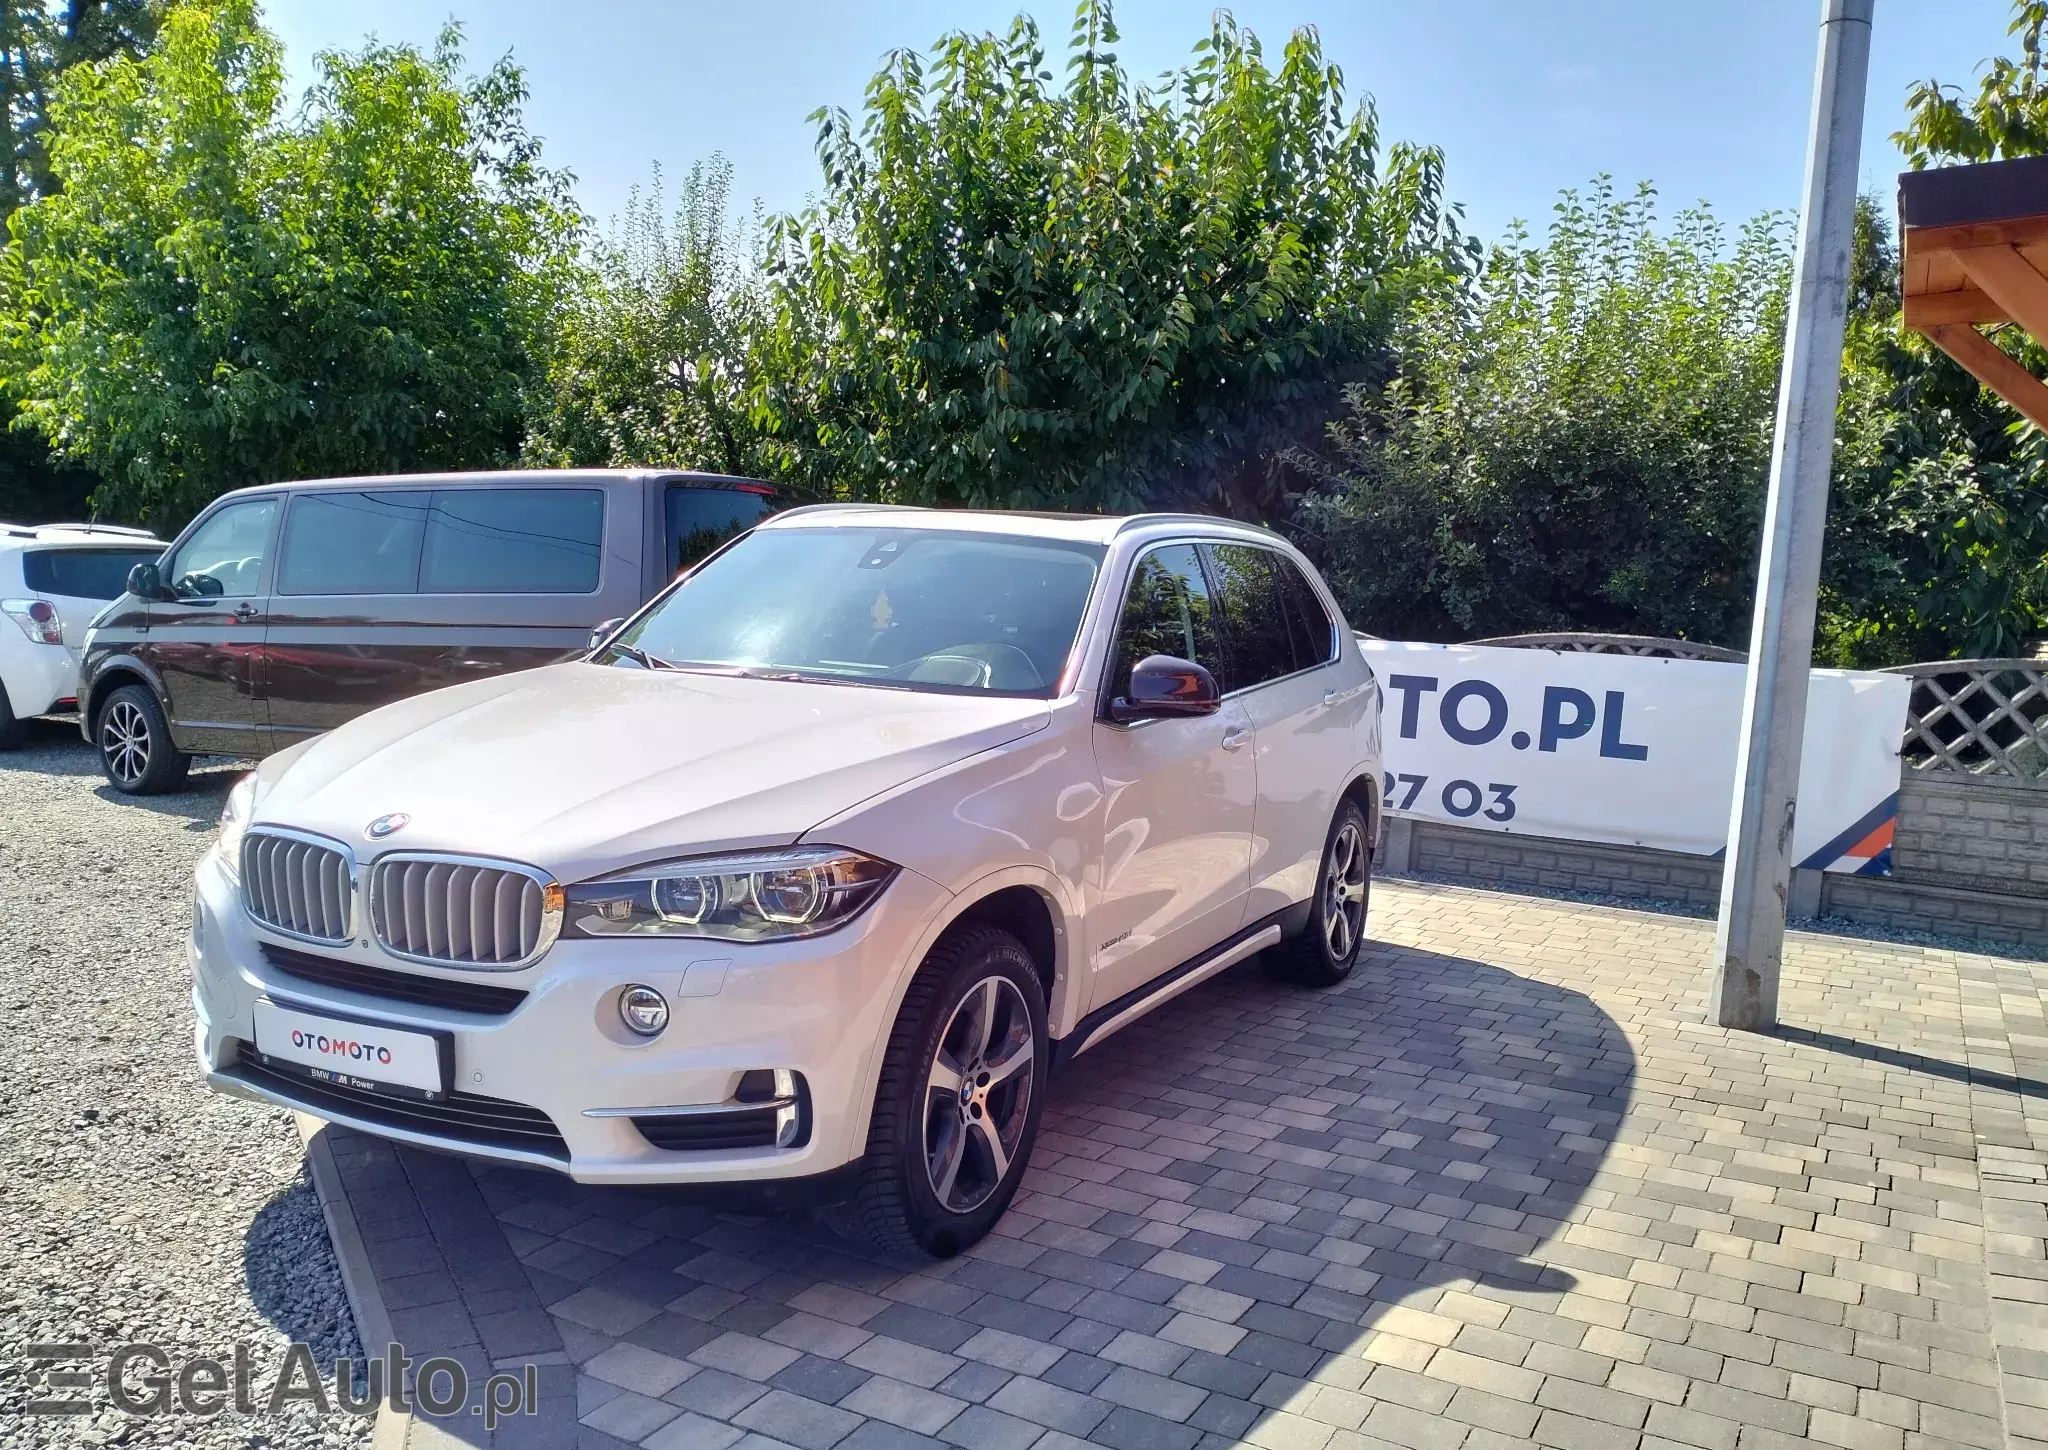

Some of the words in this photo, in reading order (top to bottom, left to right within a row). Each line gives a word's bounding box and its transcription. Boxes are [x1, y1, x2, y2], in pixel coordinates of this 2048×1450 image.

[1380, 673, 1649, 762] TO.PL
[291, 1029, 392, 1065] OTOMOTO
[311, 1068, 330, 1081] BMW
[351, 1077, 375, 1090] Power
